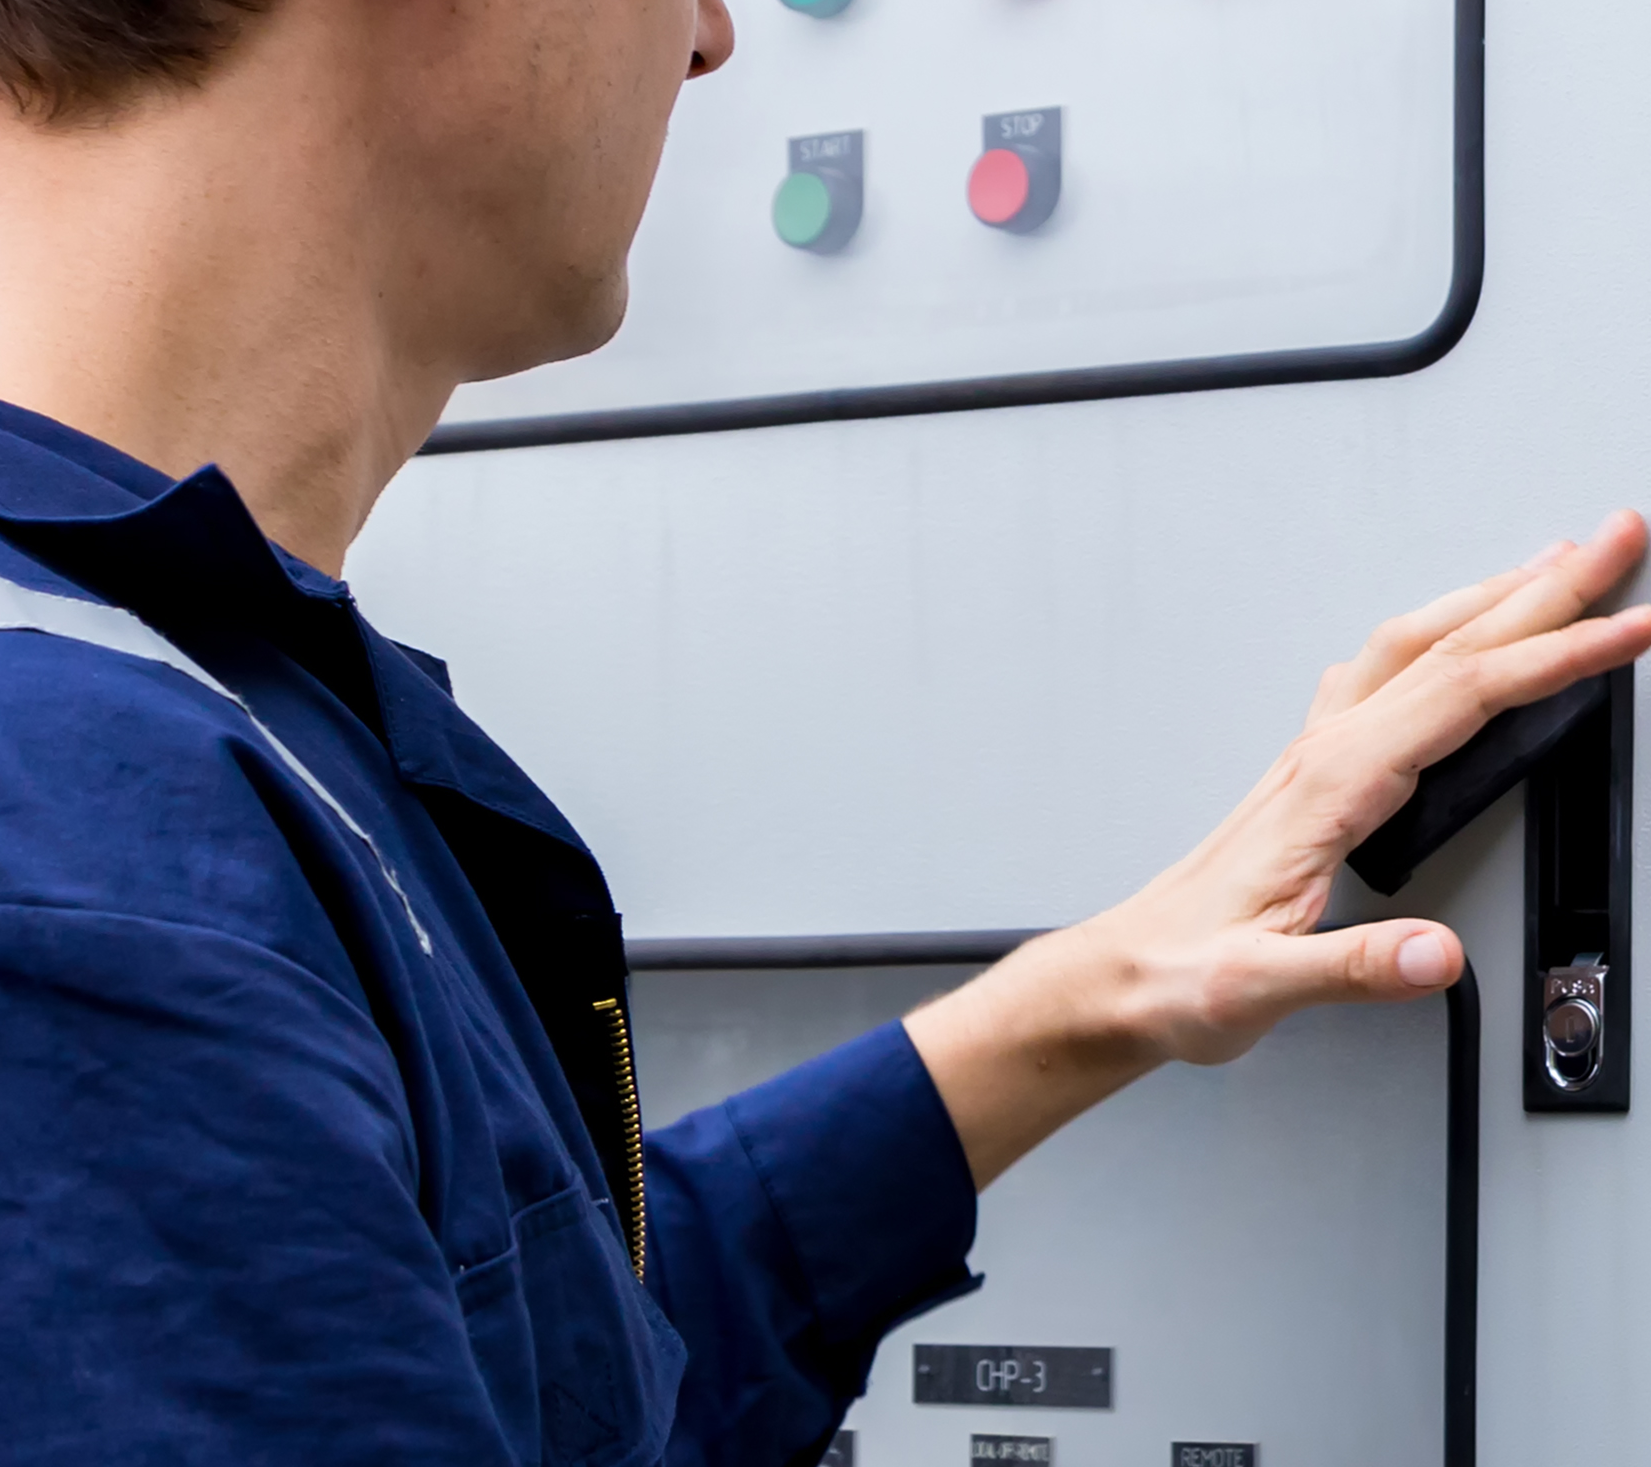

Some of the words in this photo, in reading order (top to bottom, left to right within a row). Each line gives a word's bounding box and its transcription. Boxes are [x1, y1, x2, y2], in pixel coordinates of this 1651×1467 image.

[1000, 113, 1045, 140] STOP
[799, 134, 850, 163] START
[976, 1358, 1046, 1393] CHP-3
